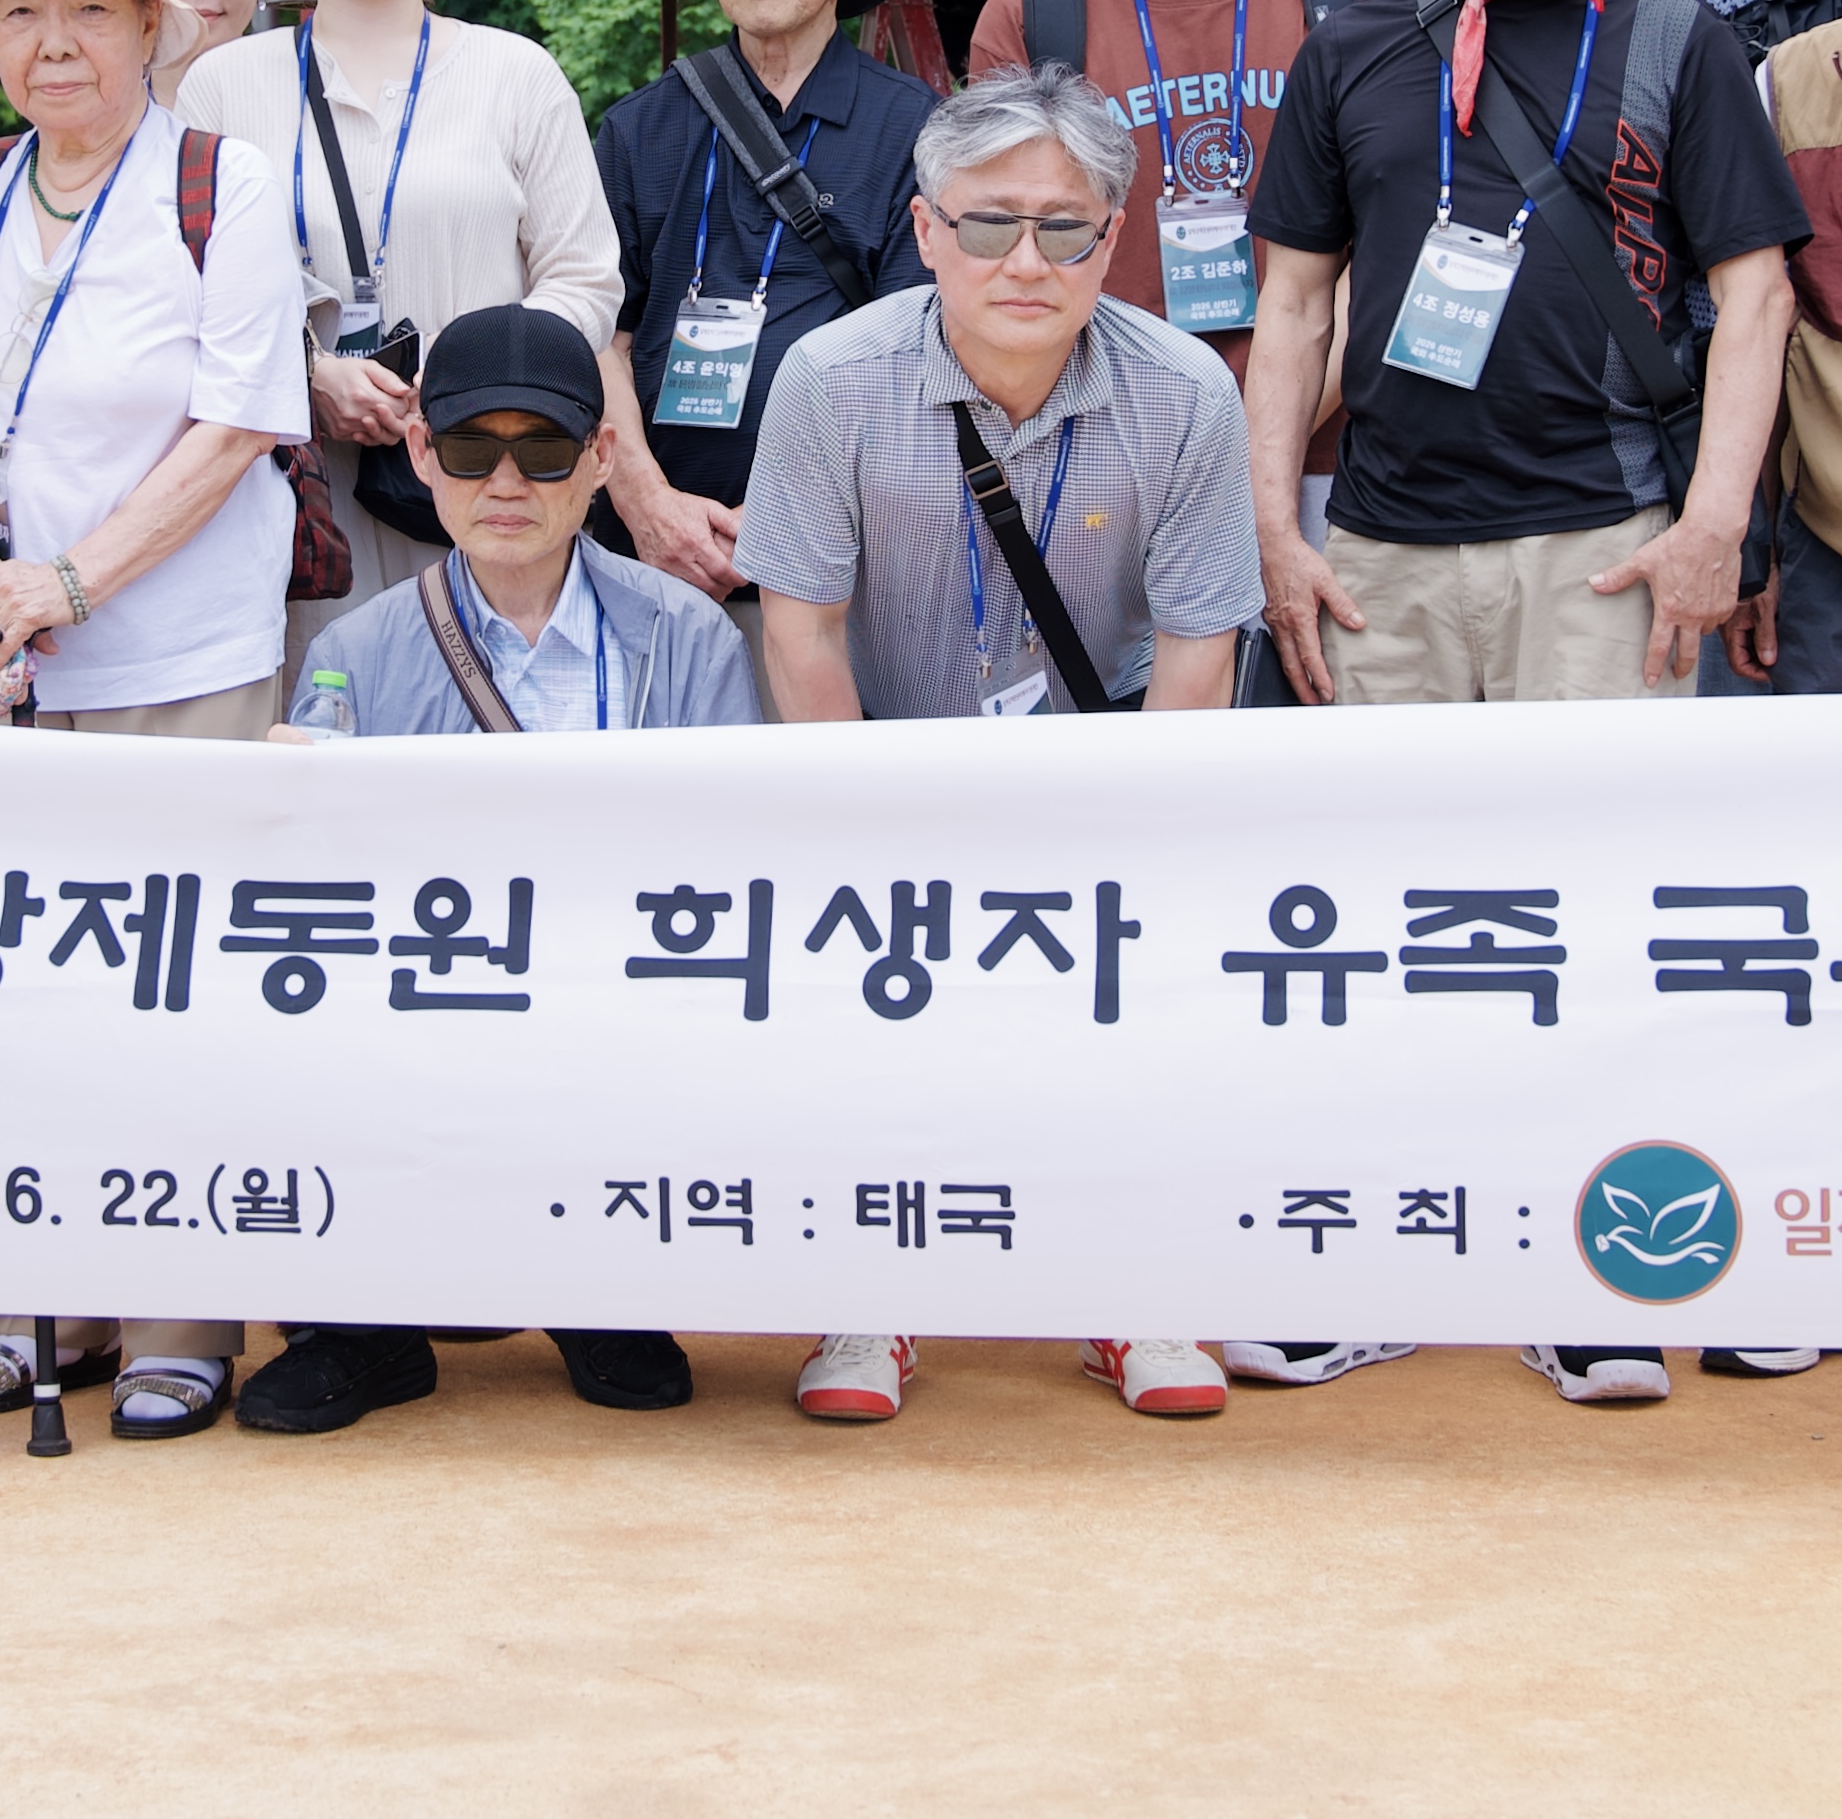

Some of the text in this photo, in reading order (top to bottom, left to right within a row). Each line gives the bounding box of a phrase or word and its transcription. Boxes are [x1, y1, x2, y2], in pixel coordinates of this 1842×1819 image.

[1106, 68, 1285, 131] AETERNU
[1170, 259, 1248, 282] 2조 김준하
[1412, 292, 1491, 330] 4조 정성용
[671, 359, 697, 375] 4조
[441, 619, 477, 679] HAZZYS
[625, 879, 1141, 1024] 희생자
[1222, 885, 1566, 1026] 유족
[6, 1166, 61, 1225] 6.
[101, 1164, 334, 1237] 22.(월)
[856, 1181, 1015, 1250] 태국
[1396, 1186, 1466, 1255] 최
